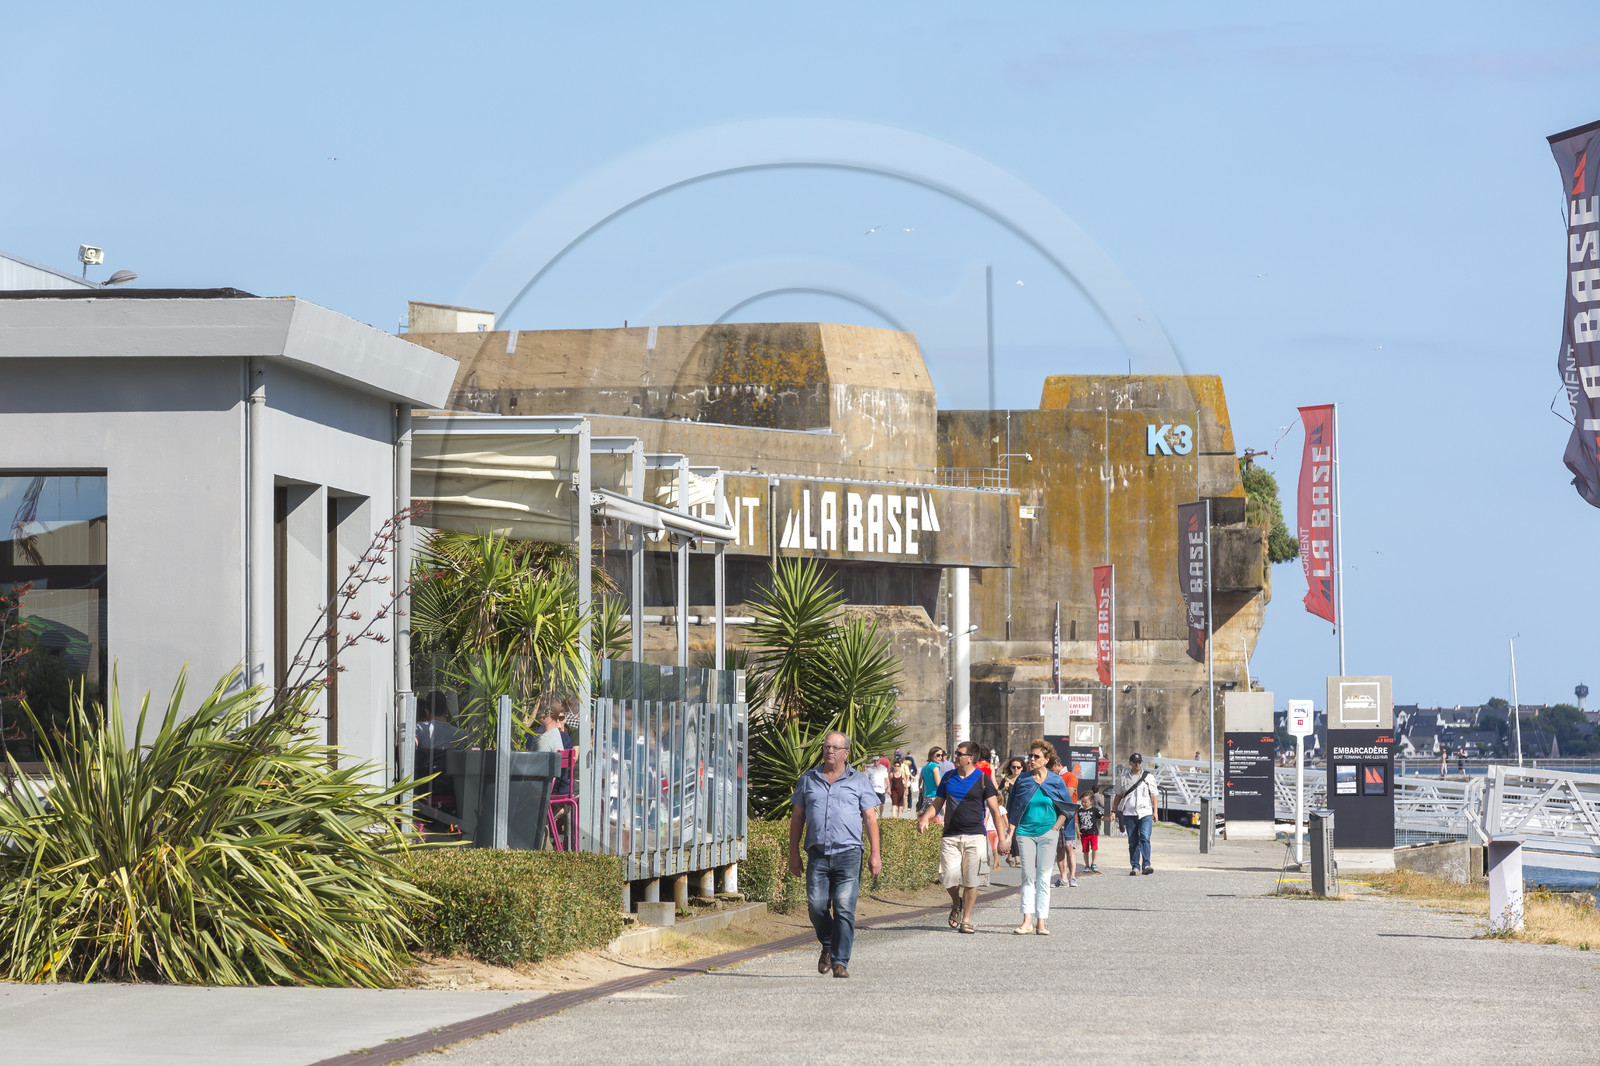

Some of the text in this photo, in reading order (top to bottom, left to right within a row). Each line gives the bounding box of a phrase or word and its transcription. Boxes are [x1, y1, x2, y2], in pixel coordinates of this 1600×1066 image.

[1569, 195, 1600, 344] BASE
[1147, 423, 1193, 456] K3
[802, 489, 919, 555] LA BASE
[1311, 445, 1331, 577] LA BASE
[1188, 532, 1204, 629] LA BASE
[1098, 587, 1110, 634] BASE
[1100, 639, 1110, 662] LA
[1333, 745, 1389, 755] EMBARCADÈRE
